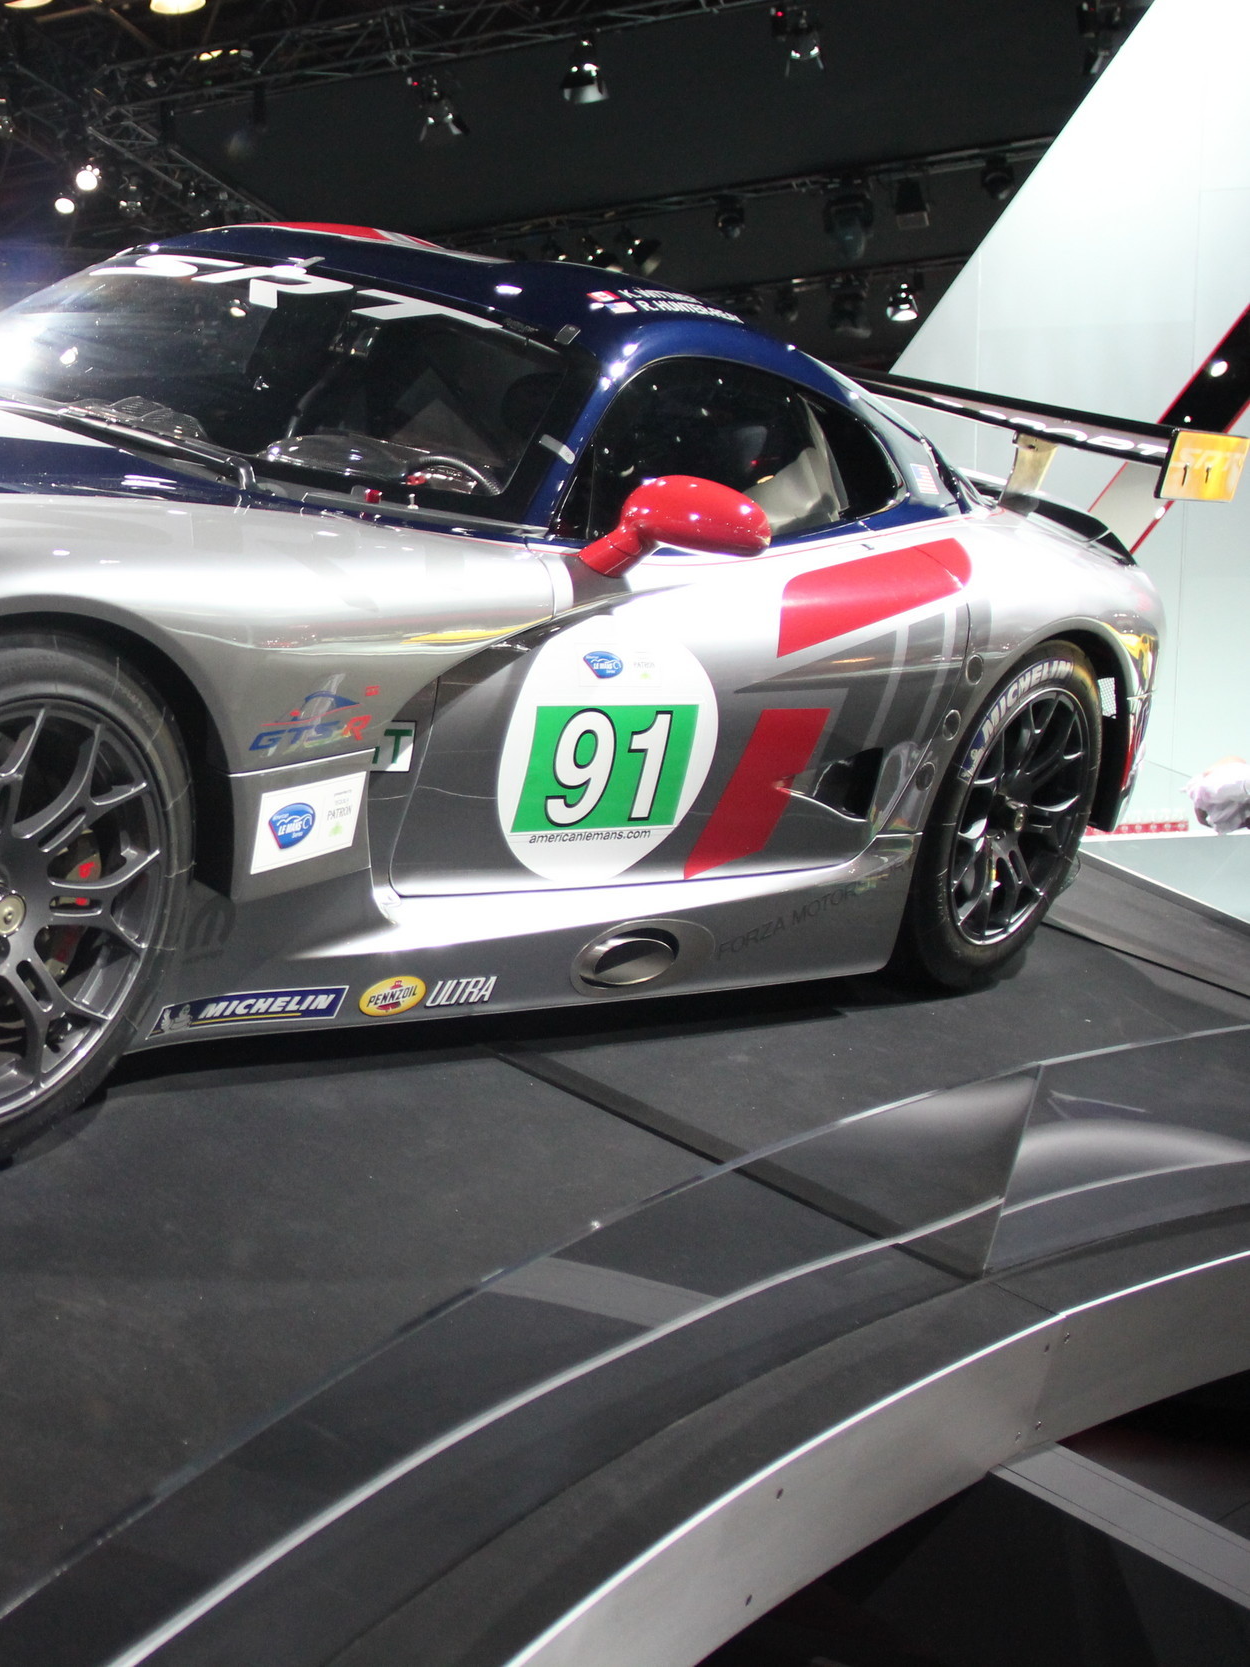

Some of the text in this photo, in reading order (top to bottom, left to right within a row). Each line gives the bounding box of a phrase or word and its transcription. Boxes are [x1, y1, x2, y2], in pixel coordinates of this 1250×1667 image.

[982, 660, 1073, 743] MICHELIN
[544, 708, 674, 828] 91
[529, 829, 651, 844] americanlemans.com
[717, 917, 786, 959] FORZA
[199, 993, 336, 1019] MICHELIN
[367, 985, 418, 1007] PENNZOIL
[424, 975, 498, 1008] ULTRA
